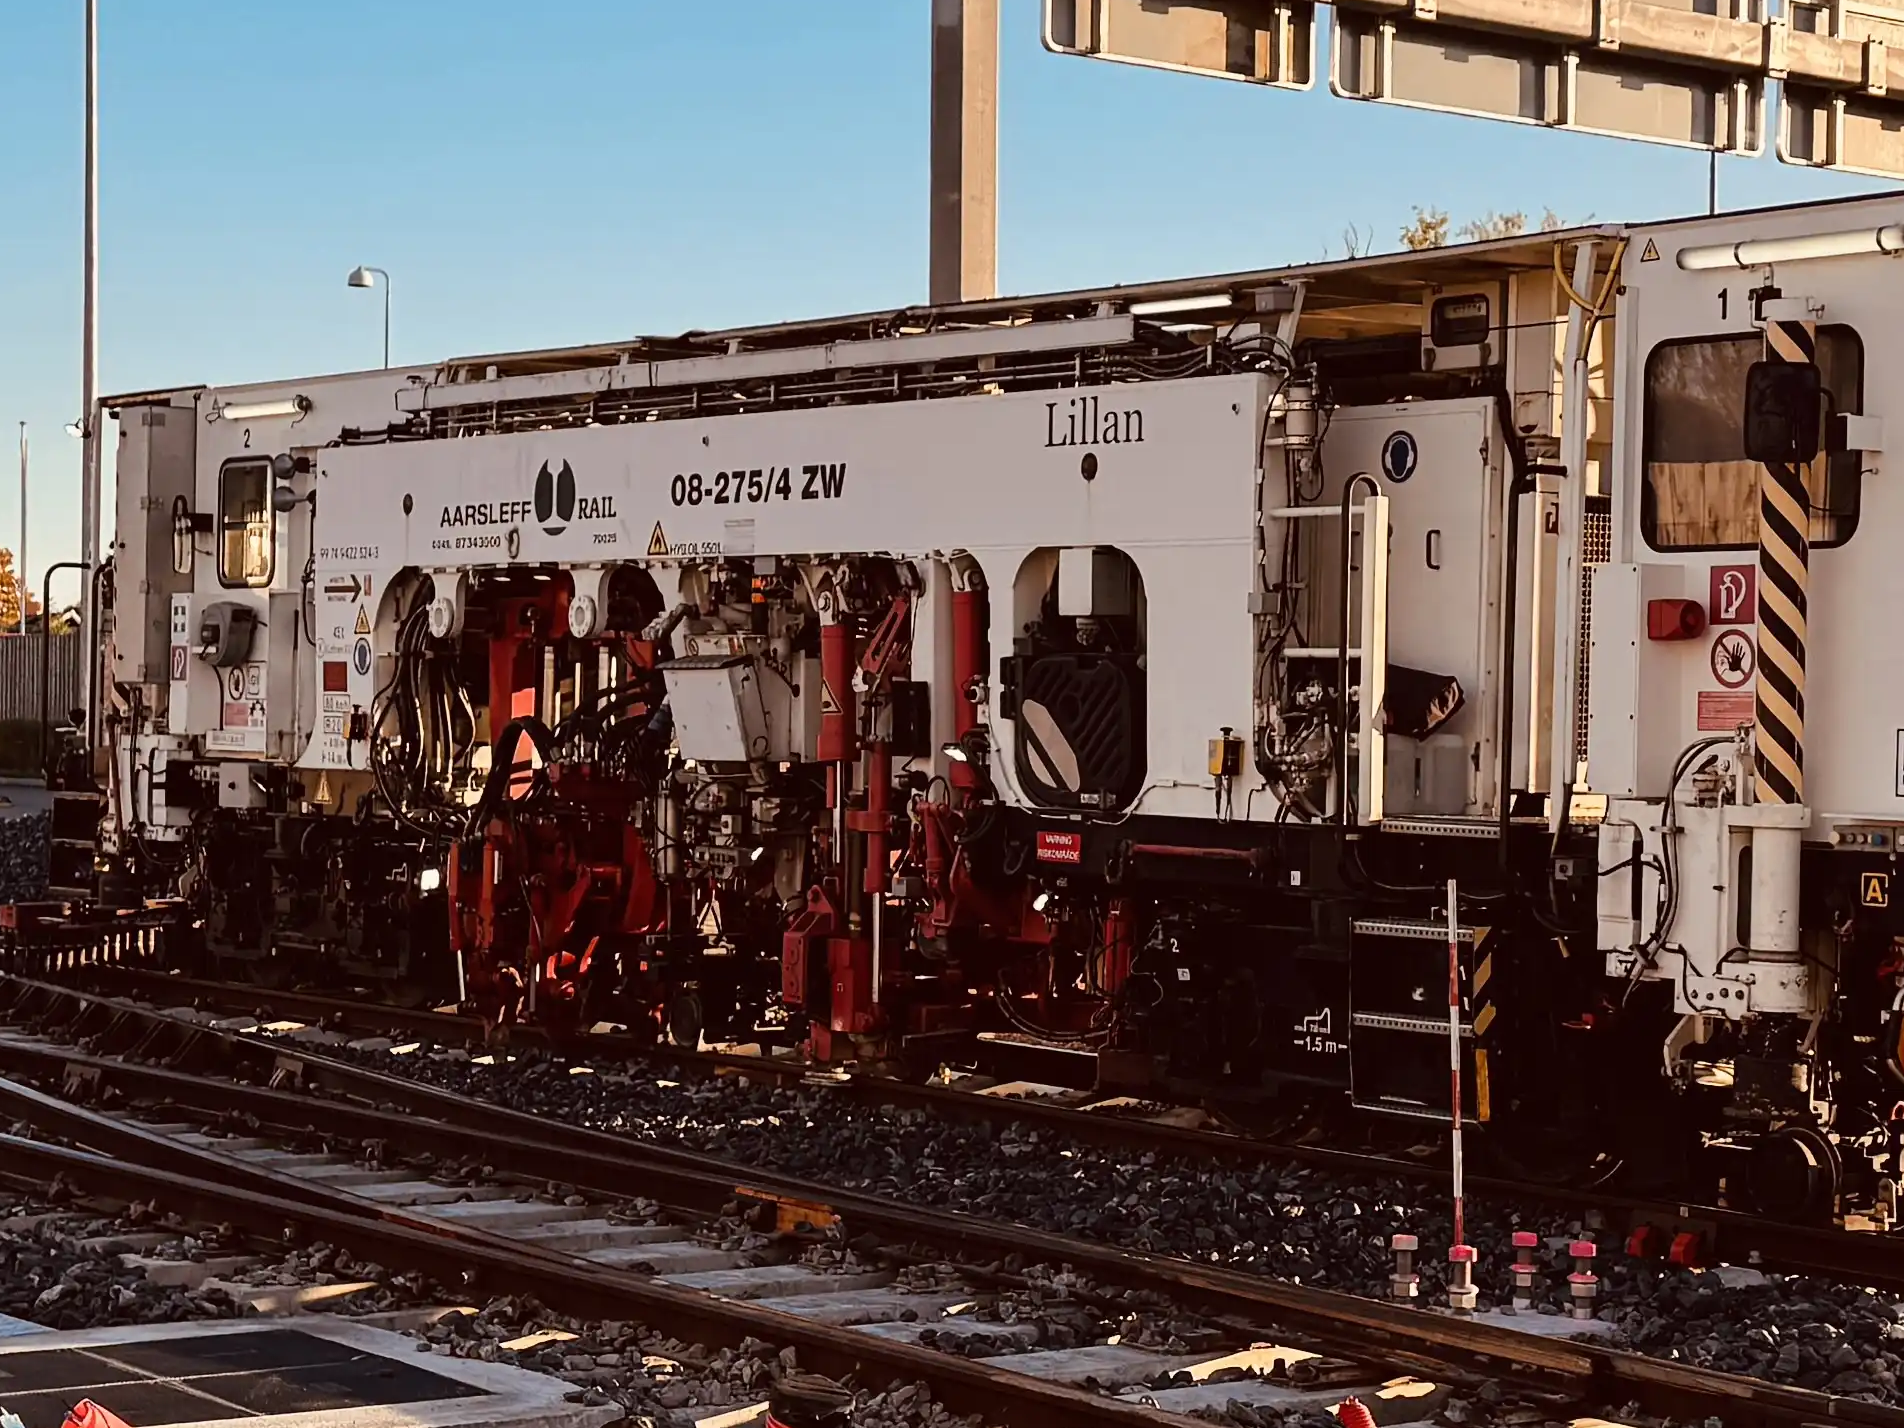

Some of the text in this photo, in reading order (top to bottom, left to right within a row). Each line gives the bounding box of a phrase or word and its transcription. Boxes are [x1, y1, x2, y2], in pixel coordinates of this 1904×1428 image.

[1717, 287, 1728, 320] 1
[1044, 395, 1145, 448] Lillan
[243, 428, 251, 448] 2
[671, 462, 846, 507] 08-275/4 ZW
[440, 495, 617, 528] AARSLEFF RAIL
[1866, 878, 1883, 902] A
[1170, 937, 1180, 953] 2
[1325, 1040, 1337, 1054] m
